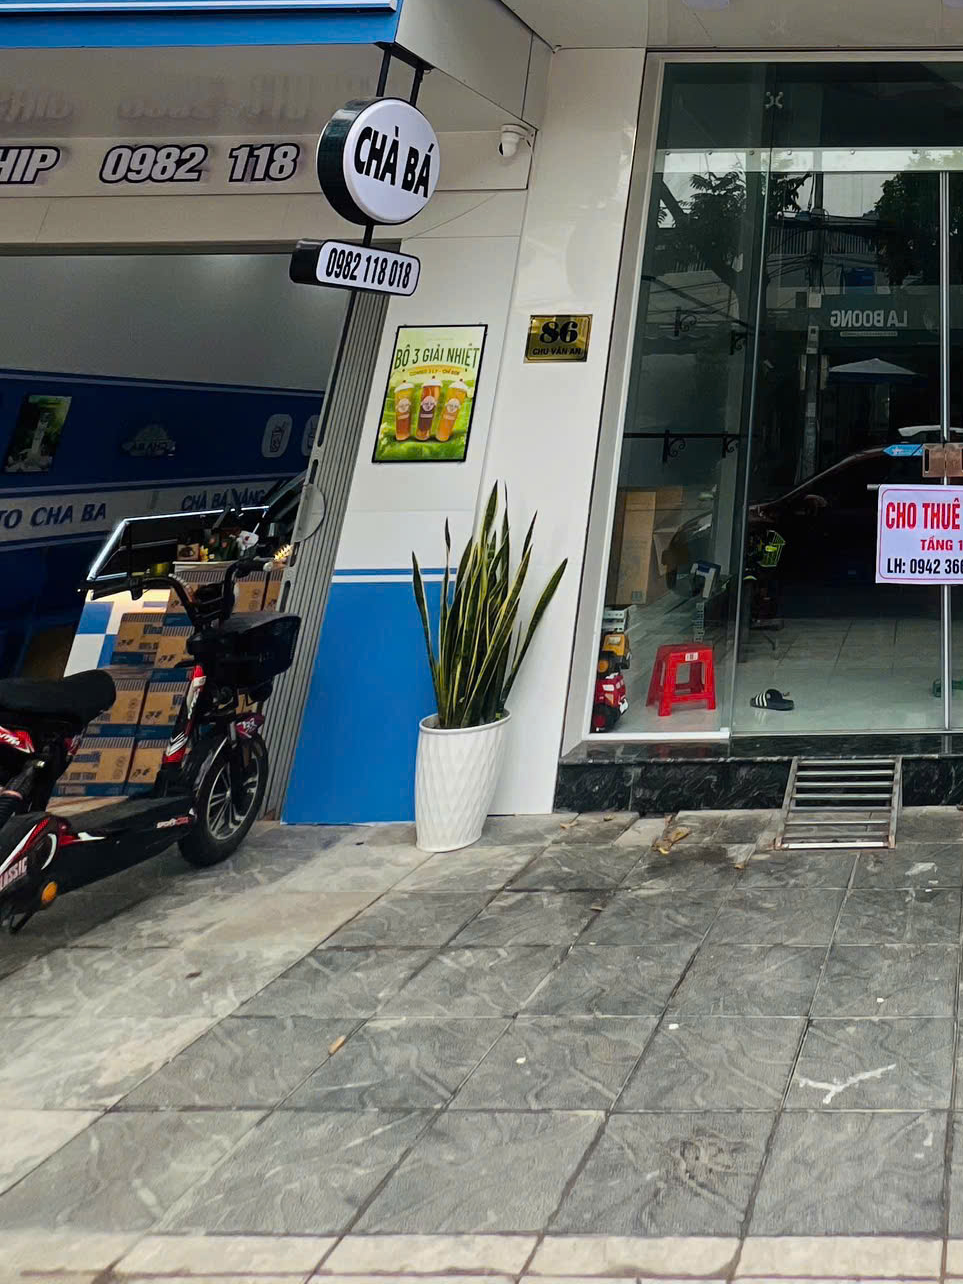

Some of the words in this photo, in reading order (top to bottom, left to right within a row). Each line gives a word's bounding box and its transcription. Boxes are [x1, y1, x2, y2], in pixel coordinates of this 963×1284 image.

[99, 144, 208, 183] 0982
[229, 143, 300, 182] 118
[354, 126, 399, 186] CHÀ
[401, 143, 435, 198] BÁ
[325, 247, 362, 281] 0982
[363, 255, 388, 285] 118
[388, 259, 412, 289] 018
[540, 321, 578, 343] 86
[412, 348, 420, 364] 3
[422, 344, 444, 363] GIẢI
[532, 347, 549, 355] CHU
[569, 347, 581, 355] AN
[886, 502, 917, 529] CHO
[922, 498, 960, 529] THUÊ
[958, 539, 963, 551] 1
[887, 558, 906, 574] LH:
[910, 559, 941, 574] 0942
